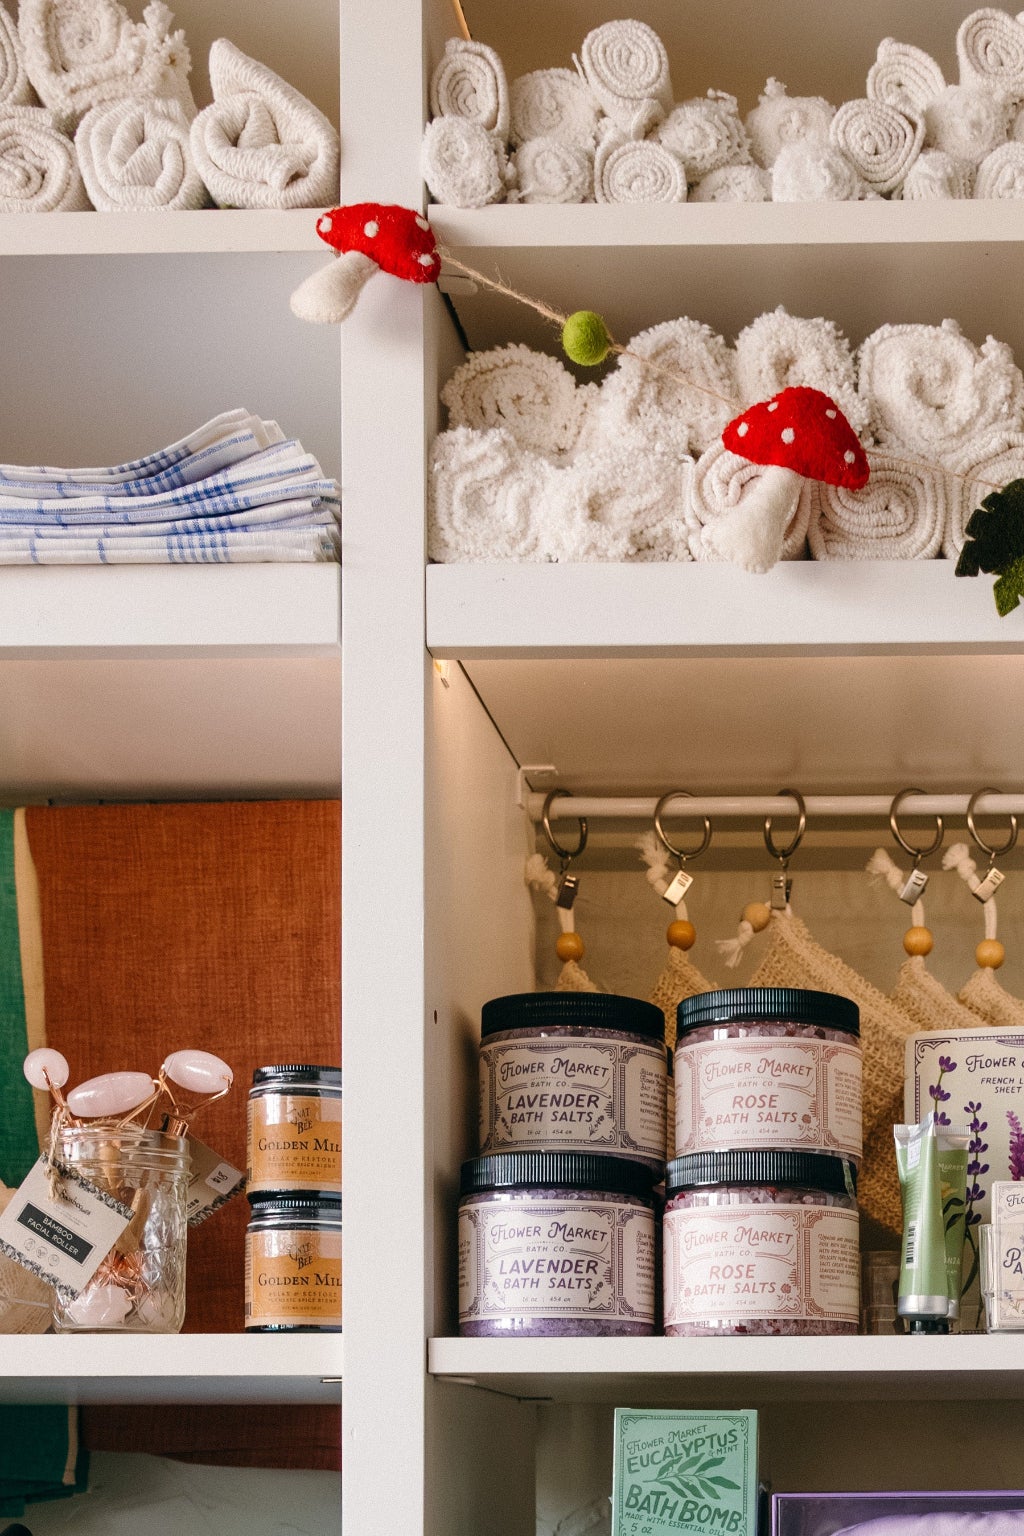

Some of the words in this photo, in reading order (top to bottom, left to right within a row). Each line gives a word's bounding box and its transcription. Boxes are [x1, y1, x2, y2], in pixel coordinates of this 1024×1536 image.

[500, 1061, 544, 1081] FLOWER
[550, 1057, 609, 1078] MARKET
[705, 1061, 751, 1081] FLOWER
[757, 1057, 813, 1077] MARKET
[965, 1055, 1016, 1072] FLOWER
[980, 1077, 1015, 1085] FRENCH
[994, 1086, 1021, 1094] SHEET
[507, 1093, 600, 1111] LAVENDER
[732, 1094, 779, 1109] ROSE
[510, 1111, 543, 1124] BATH
[550, 1111, 593, 1122] SALTS
[716, 1112, 748, 1125] BATH
[758, 1112, 798, 1123] SALTS
[258, 1138, 309, 1150] GOLDEN
[313, 1138, 342, 1152] MIL
[27, 1218, 50, 1237] FACIAL
[51, 1234, 79, 1255] ROLLER
[42, 1217, 73, 1240] BAMBOO
[490, 1224, 541, 1244] FLOWER
[548, 1221, 607, 1242] MARKET
[684, 1231, 728, 1250] FLOWER
[734, 1226, 793, 1246] MARKET
[499, 1259, 599, 1275] LAVENDER
[709, 1264, 756, 1279] ROSE
[504, 1278, 539, 1289] BATH
[549, 1278, 592, 1289] SALTS
[694, 1284, 725, 1296] BATH
[734, 1282, 776, 1294] SALTS
[626, 1436, 665, 1455] FLOWER
[668, 1424, 708, 1443] MARKET
[626, 1428, 739, 1474] EUCALYPTUS
[624, 1484, 679, 1520] BATH
[678, 1499, 742, 1533] BOMB
